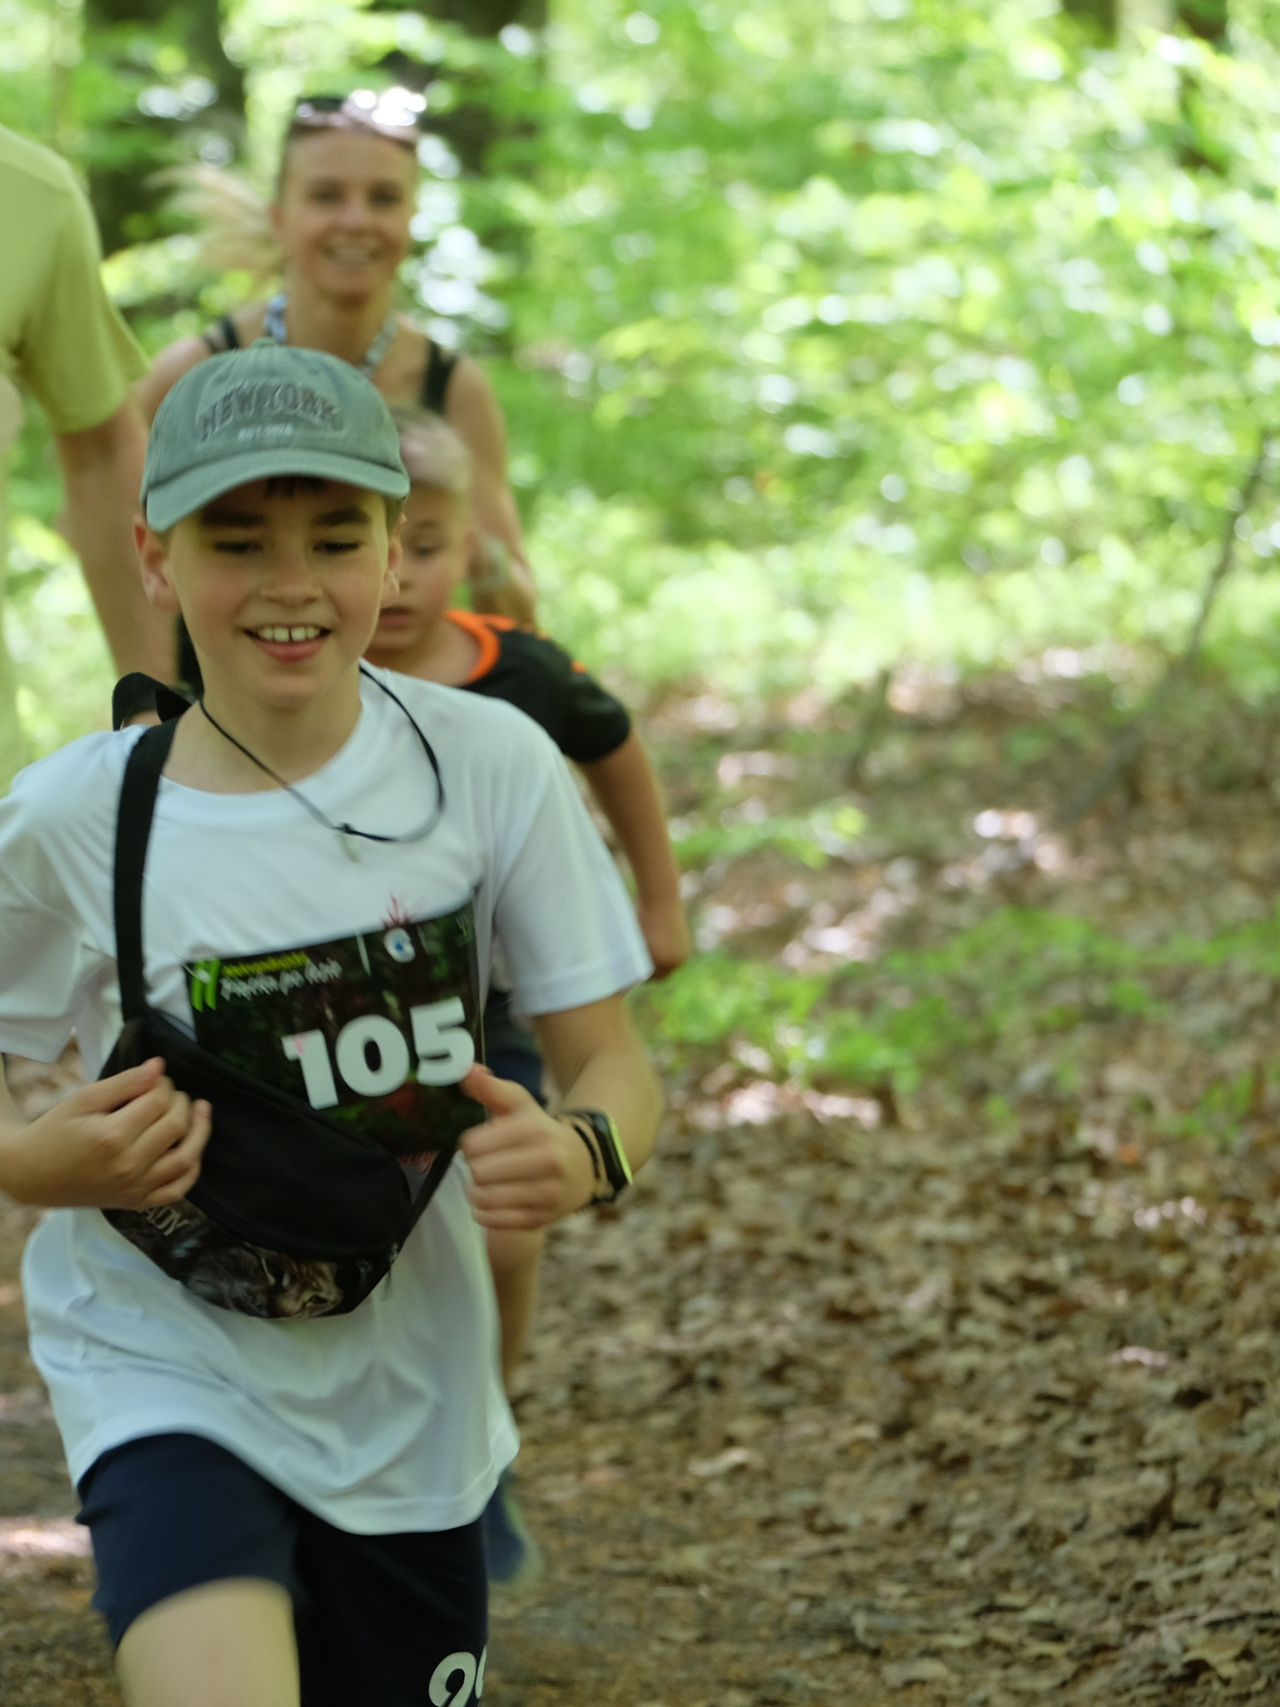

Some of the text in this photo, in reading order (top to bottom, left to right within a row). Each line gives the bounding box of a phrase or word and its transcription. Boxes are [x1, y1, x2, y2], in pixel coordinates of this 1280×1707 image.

[199, 380, 344, 443] NEW YORK
[281, 996, 475, 1110] 105
[428, 1647, 487, 1707] 9
